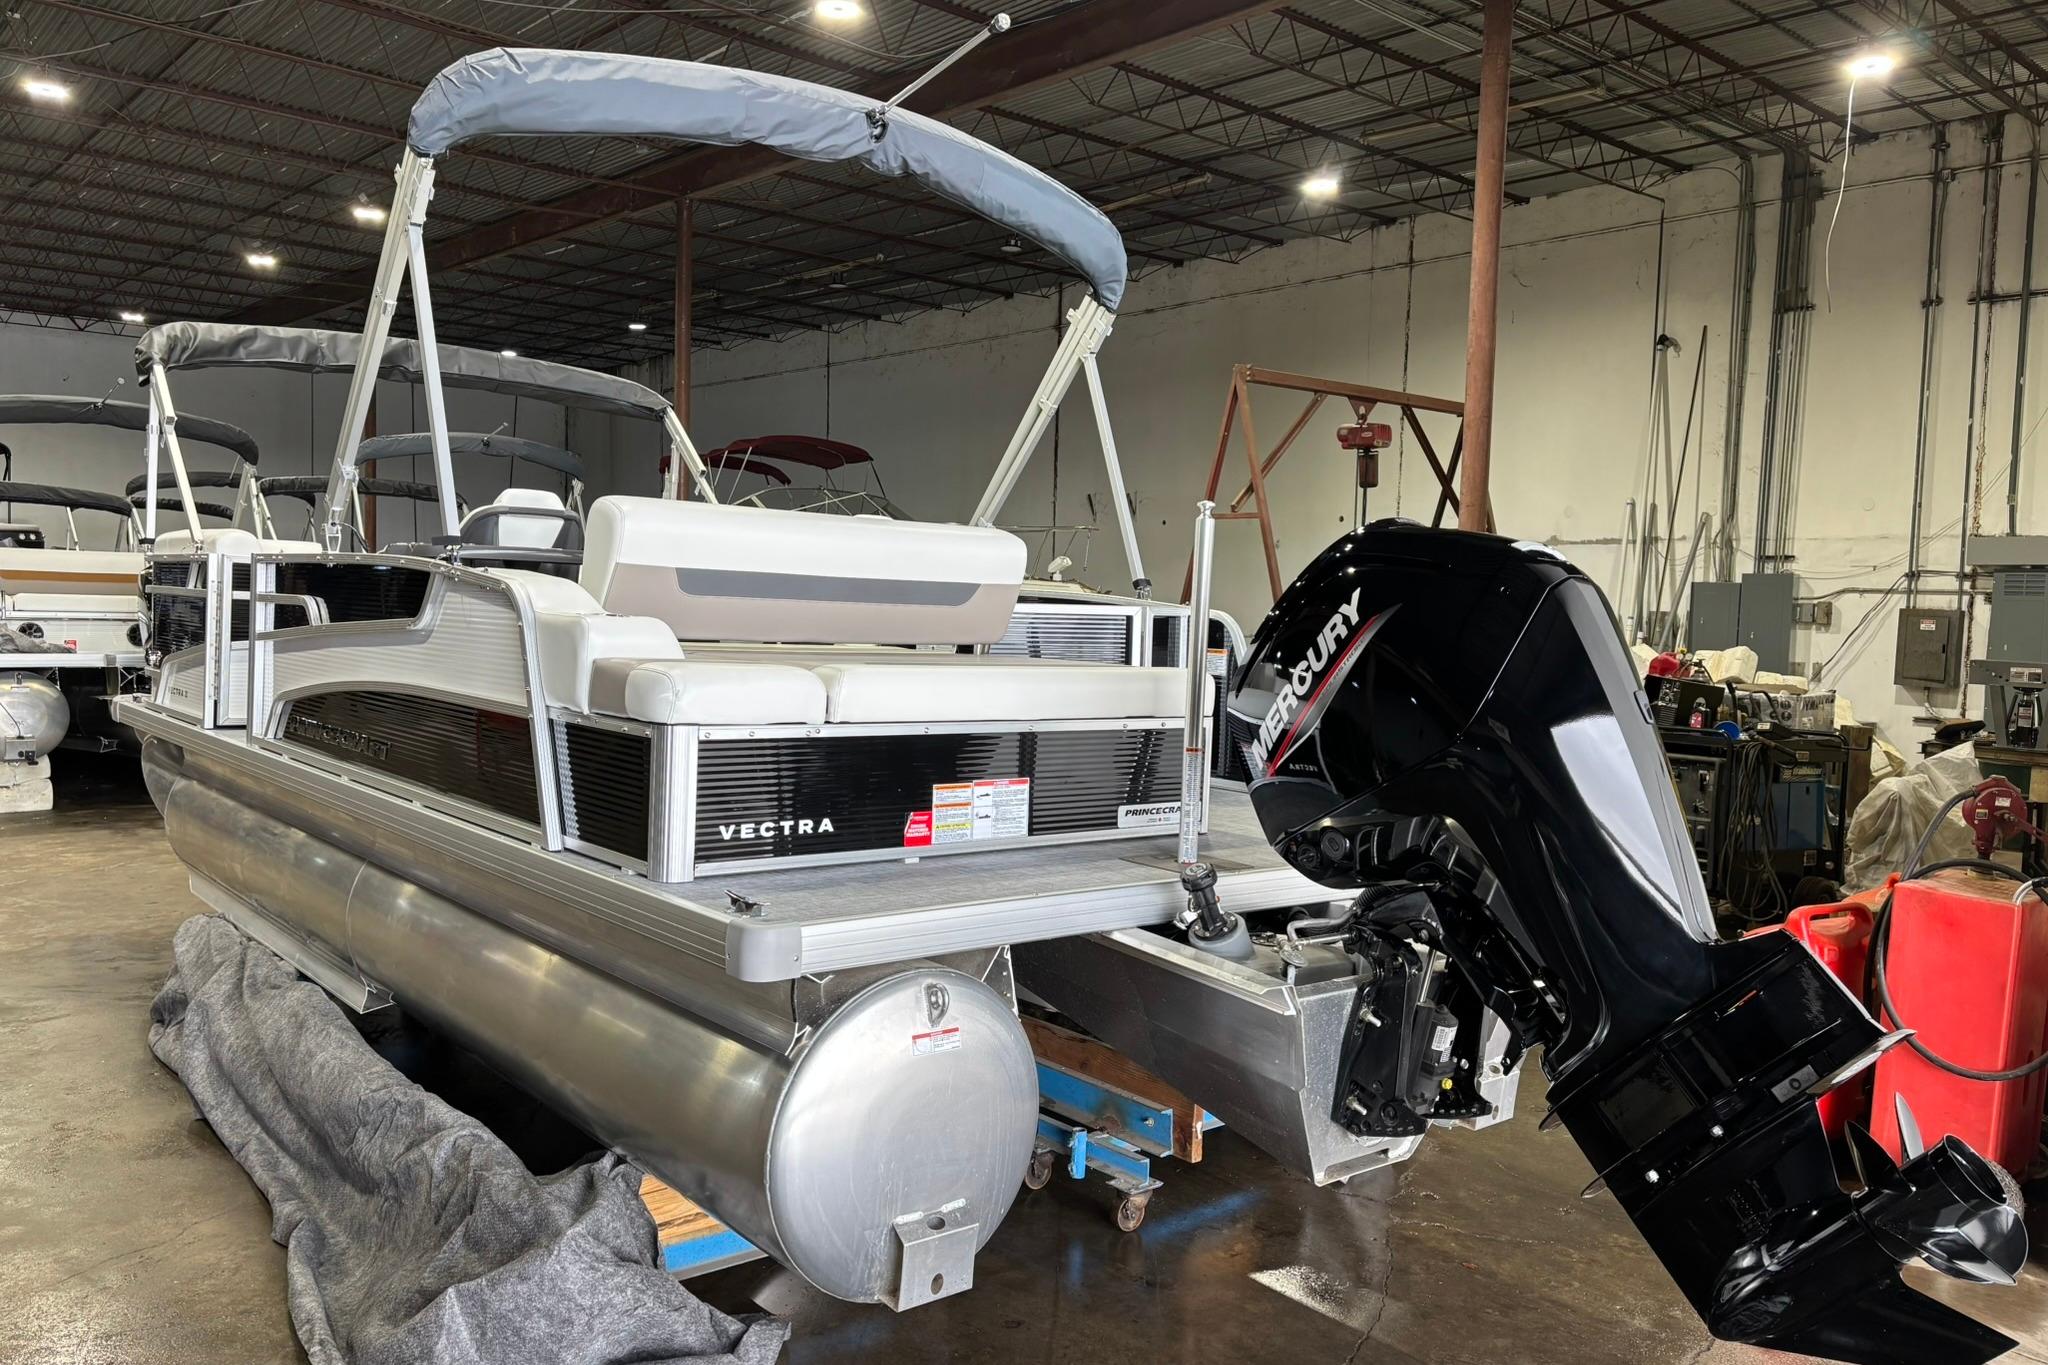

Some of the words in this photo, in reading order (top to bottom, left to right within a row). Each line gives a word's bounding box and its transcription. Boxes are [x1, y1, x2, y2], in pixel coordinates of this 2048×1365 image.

[1251, 586, 1362, 771] MERCURY
[1125, 806, 1182, 817] PRINCECRA
[719, 818, 835, 841] VECTRA
